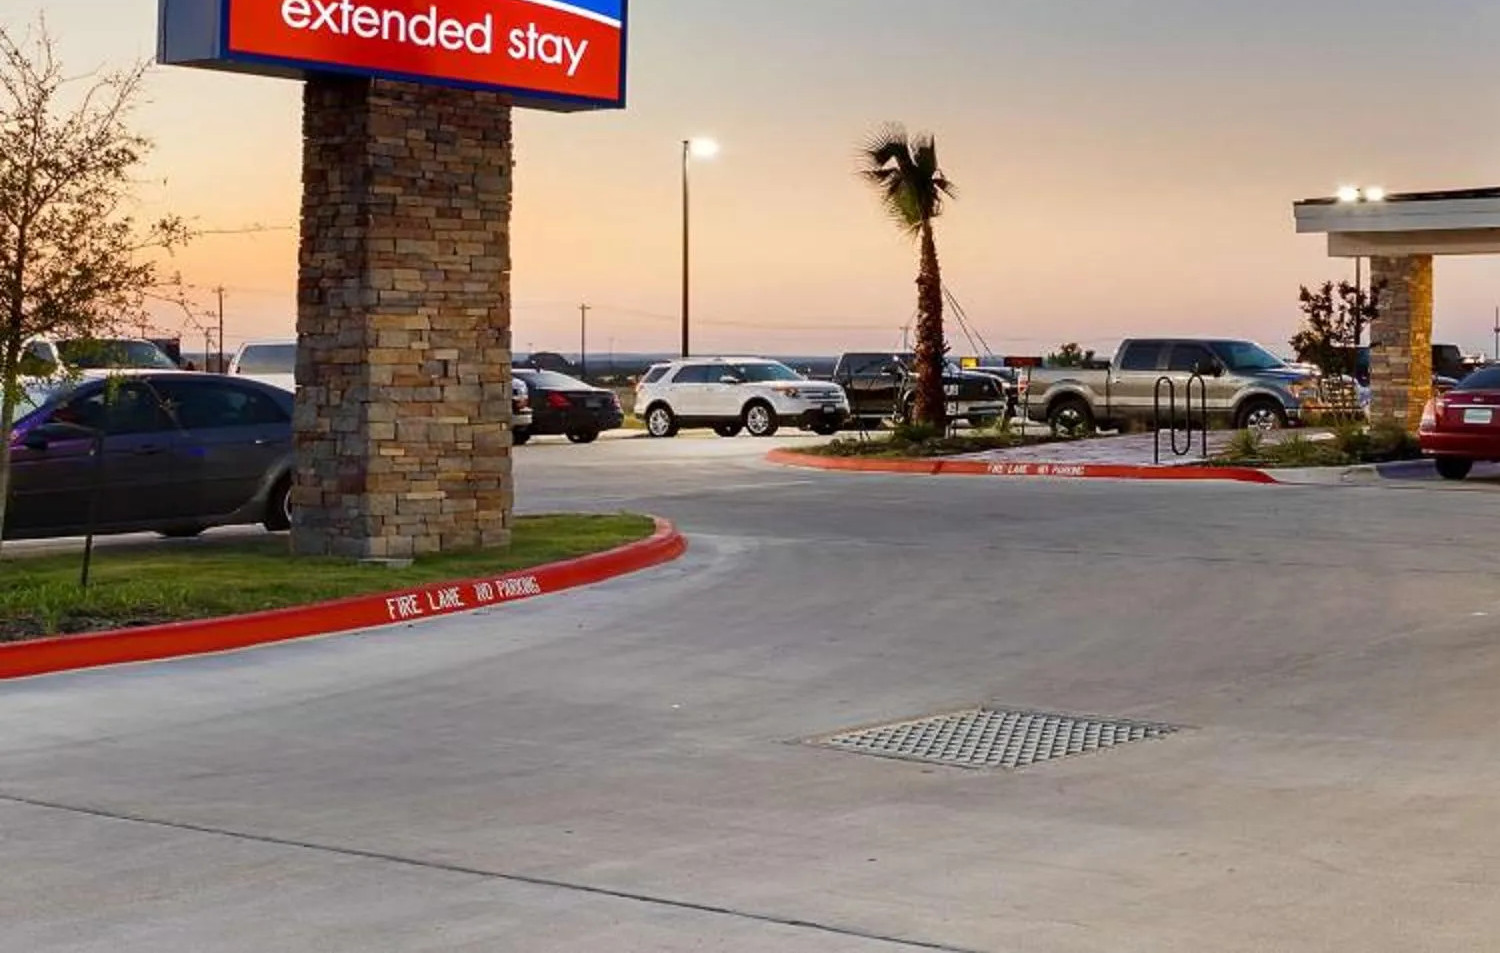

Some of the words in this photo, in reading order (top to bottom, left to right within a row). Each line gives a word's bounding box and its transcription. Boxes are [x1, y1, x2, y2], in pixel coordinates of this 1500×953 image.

[508, 22, 589, 77] stay
[385, 594, 423, 620] FIRE
[426, 586, 465, 611] LANE
[472, 582, 495, 603] NO
[496, 576, 541, 599] PARKING
